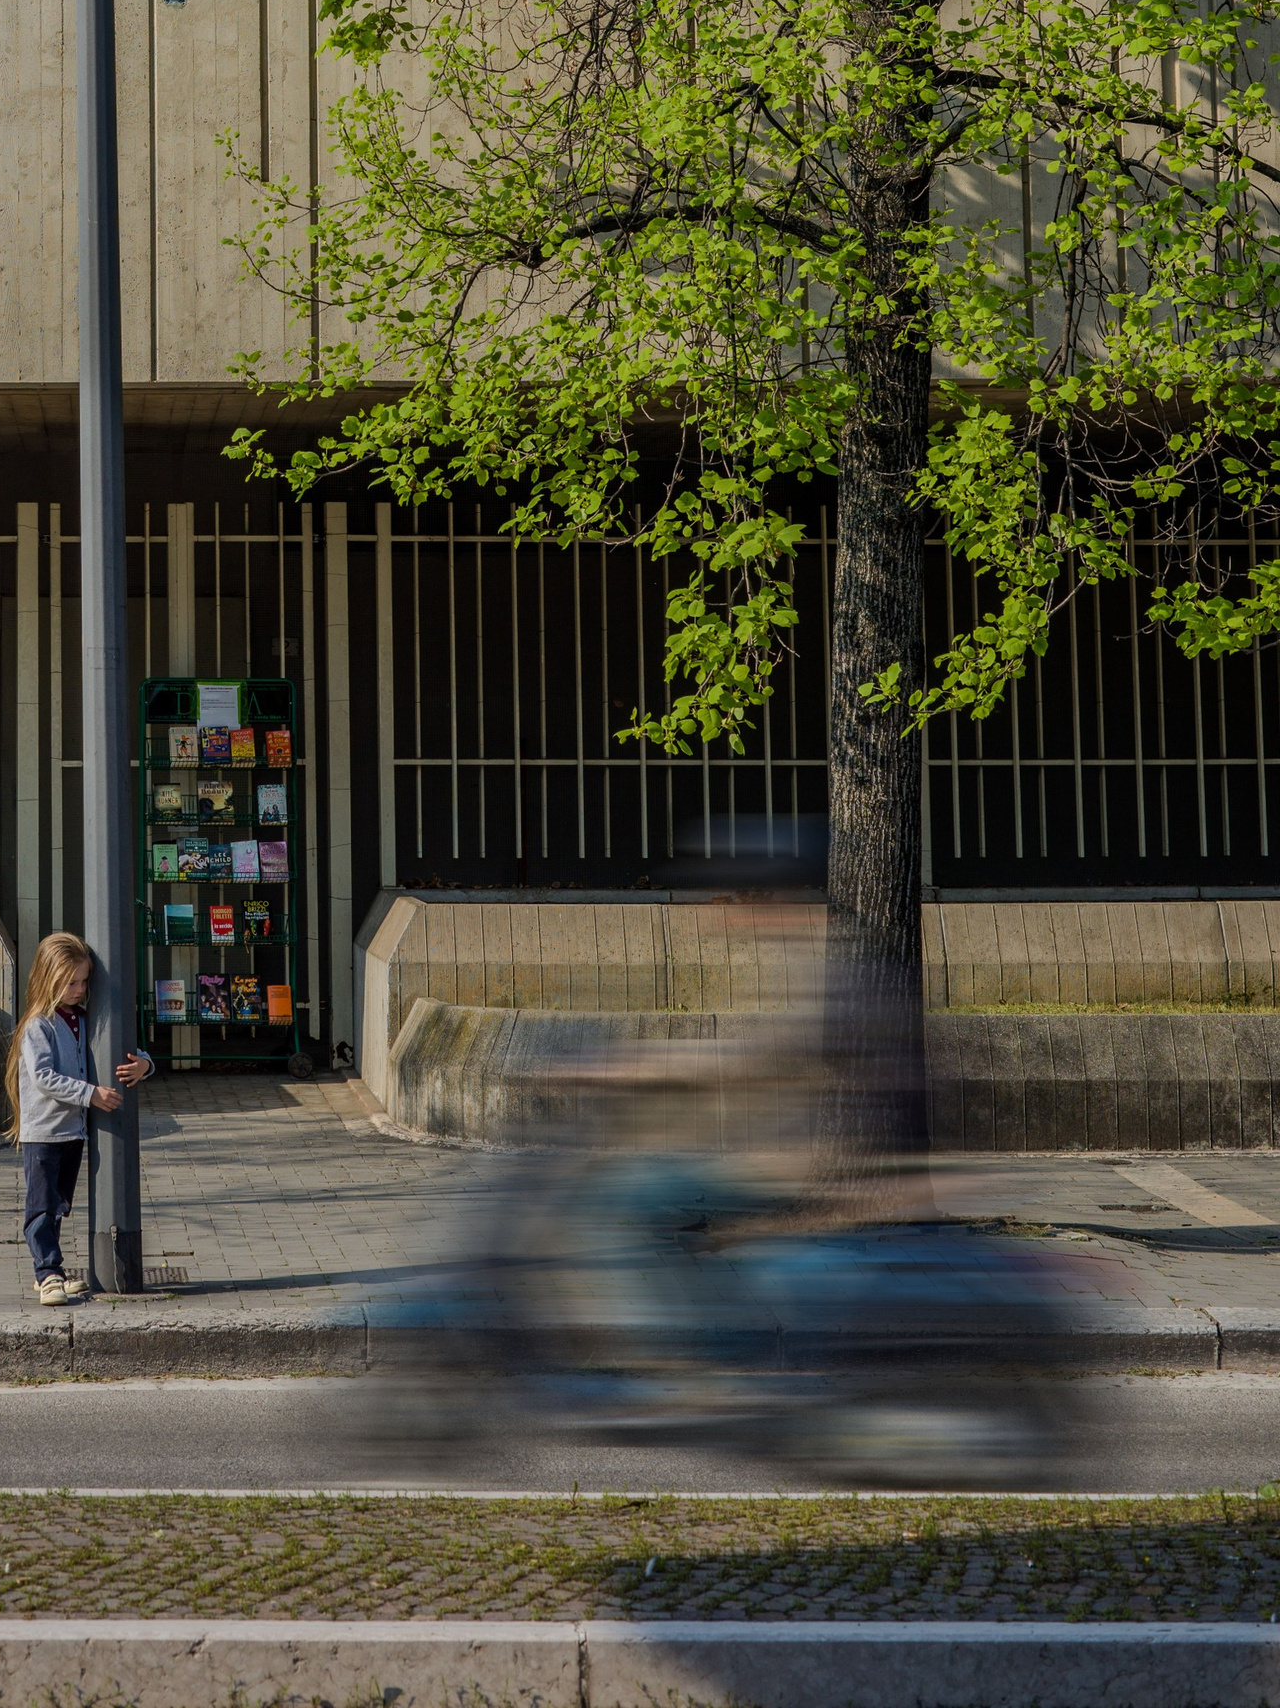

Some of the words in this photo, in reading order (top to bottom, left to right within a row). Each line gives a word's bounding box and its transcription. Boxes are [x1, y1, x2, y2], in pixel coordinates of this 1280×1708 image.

[201, 788, 229, 796] Beauty
[157, 797, 179, 805] RUNNER
[198, 975, 225, 986] Ruby
